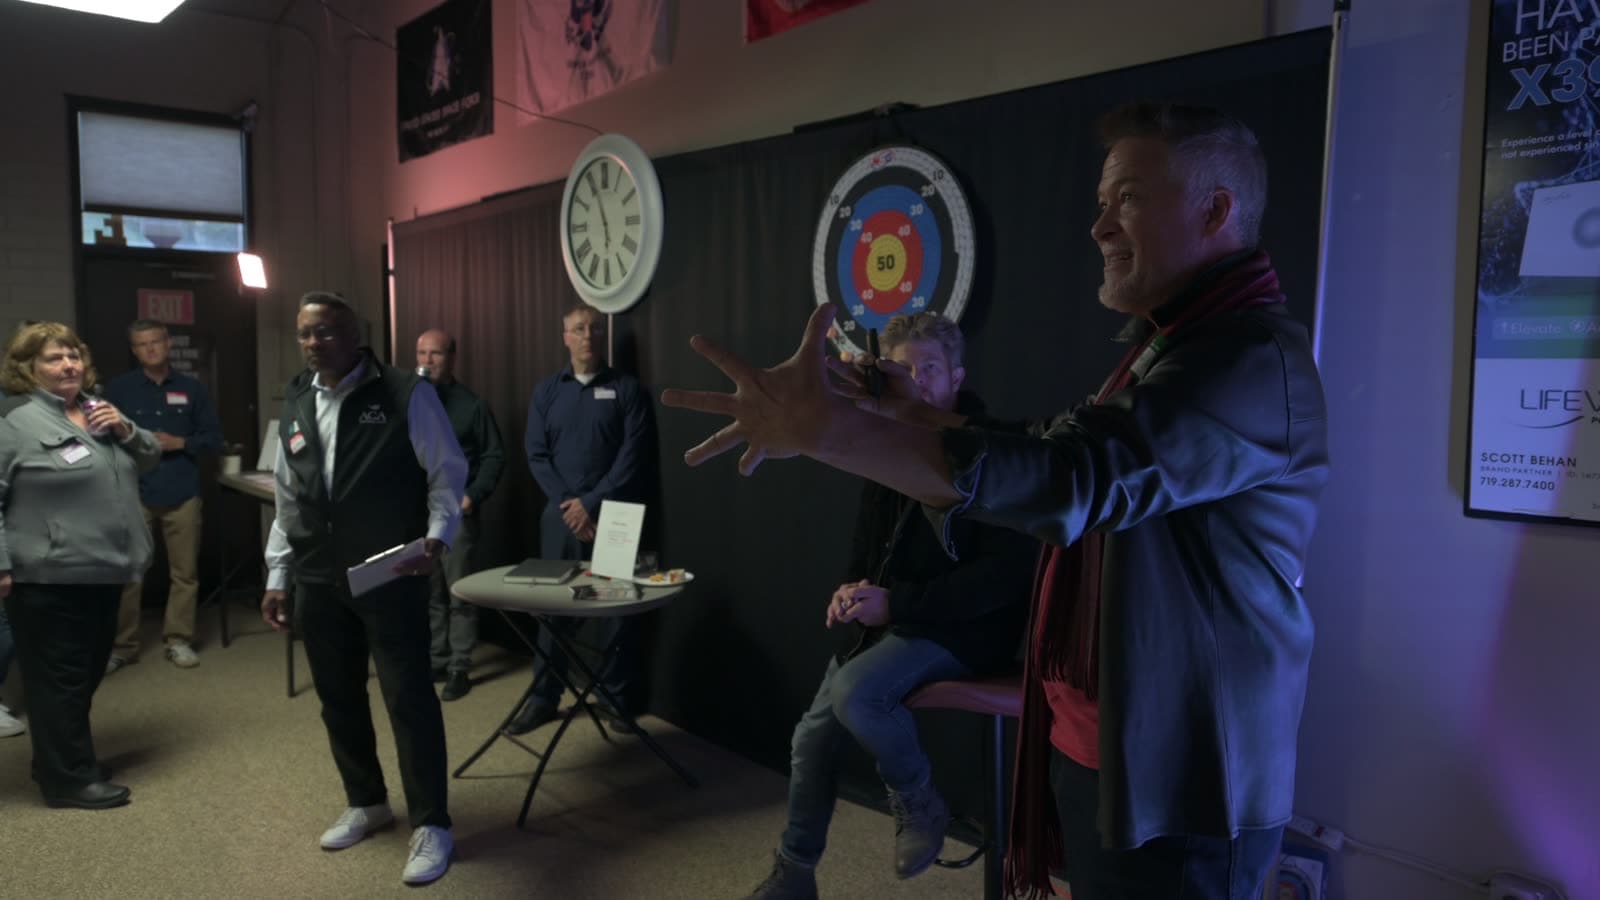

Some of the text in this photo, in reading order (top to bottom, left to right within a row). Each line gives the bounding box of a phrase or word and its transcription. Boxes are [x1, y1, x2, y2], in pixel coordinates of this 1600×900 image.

[1503, 31, 1569, 63] BEEN
[1502, 134, 1555, 149] Experience
[1502, 150, 1517, 160] not
[1520, 141, 1581, 158] experienced
[932, 168, 945, 181] 10
[921, 184, 936, 197] 20
[839, 205, 852, 218] 20
[909, 203, 924, 216] 30
[850, 219, 863, 231] 30
[898, 224, 911, 236] 40
[860, 231, 873, 243] 40
[876, 255, 895, 271] 50
[899, 282, 913, 293] 40
[861, 289, 874, 300] 40
[147, 293, 185, 320] EXIT
[911, 296, 925, 308] 30
[853, 304, 865, 316] 30
[843, 320, 856, 332] 20
[1511, 322, 1561, 335] Elevate
[1480, 452, 1577, 468] SCOTT BEHAN
[1480, 465, 1511, 473] BRAND
[1513, 467, 1552, 476] PARTNER
[1480, 476, 1556, 490] 719.287.7400
